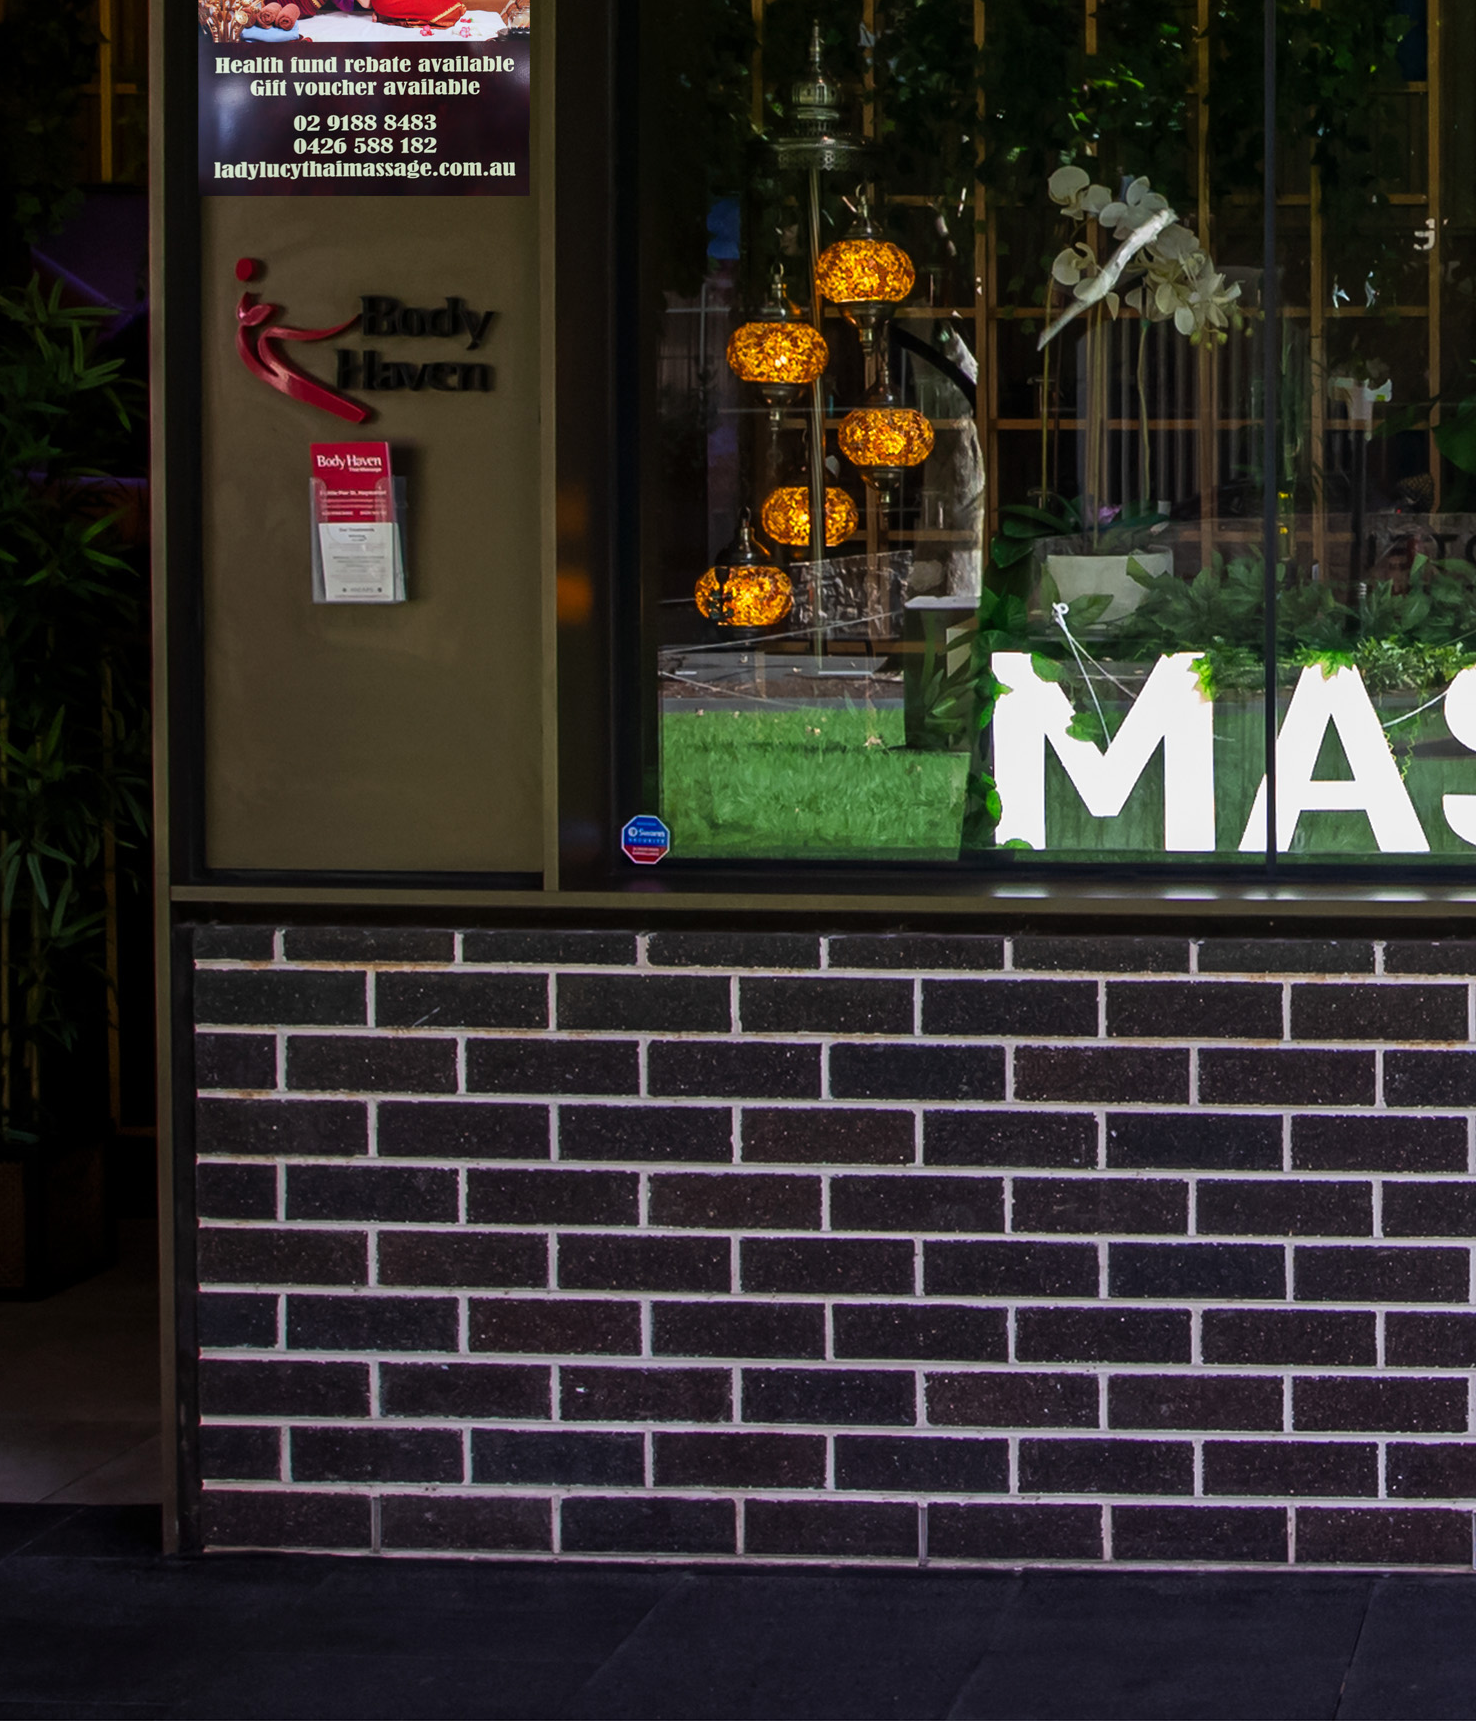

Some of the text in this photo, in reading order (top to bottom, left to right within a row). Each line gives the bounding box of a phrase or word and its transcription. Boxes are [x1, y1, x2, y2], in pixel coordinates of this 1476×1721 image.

[215, 56, 515, 73] Health fund rebate available
[250, 79, 480, 97] Gift voucher available
[293, 114, 437, 131] 02 9188 8483
[293, 137, 437, 154] 0426 588 182
[214, 161, 516, 179] ladylucythaimassage.com.au
[359, 295, 496, 350] Body
[335, 348, 495, 392] Haven
[317, 454, 382, 469] Body Haven
